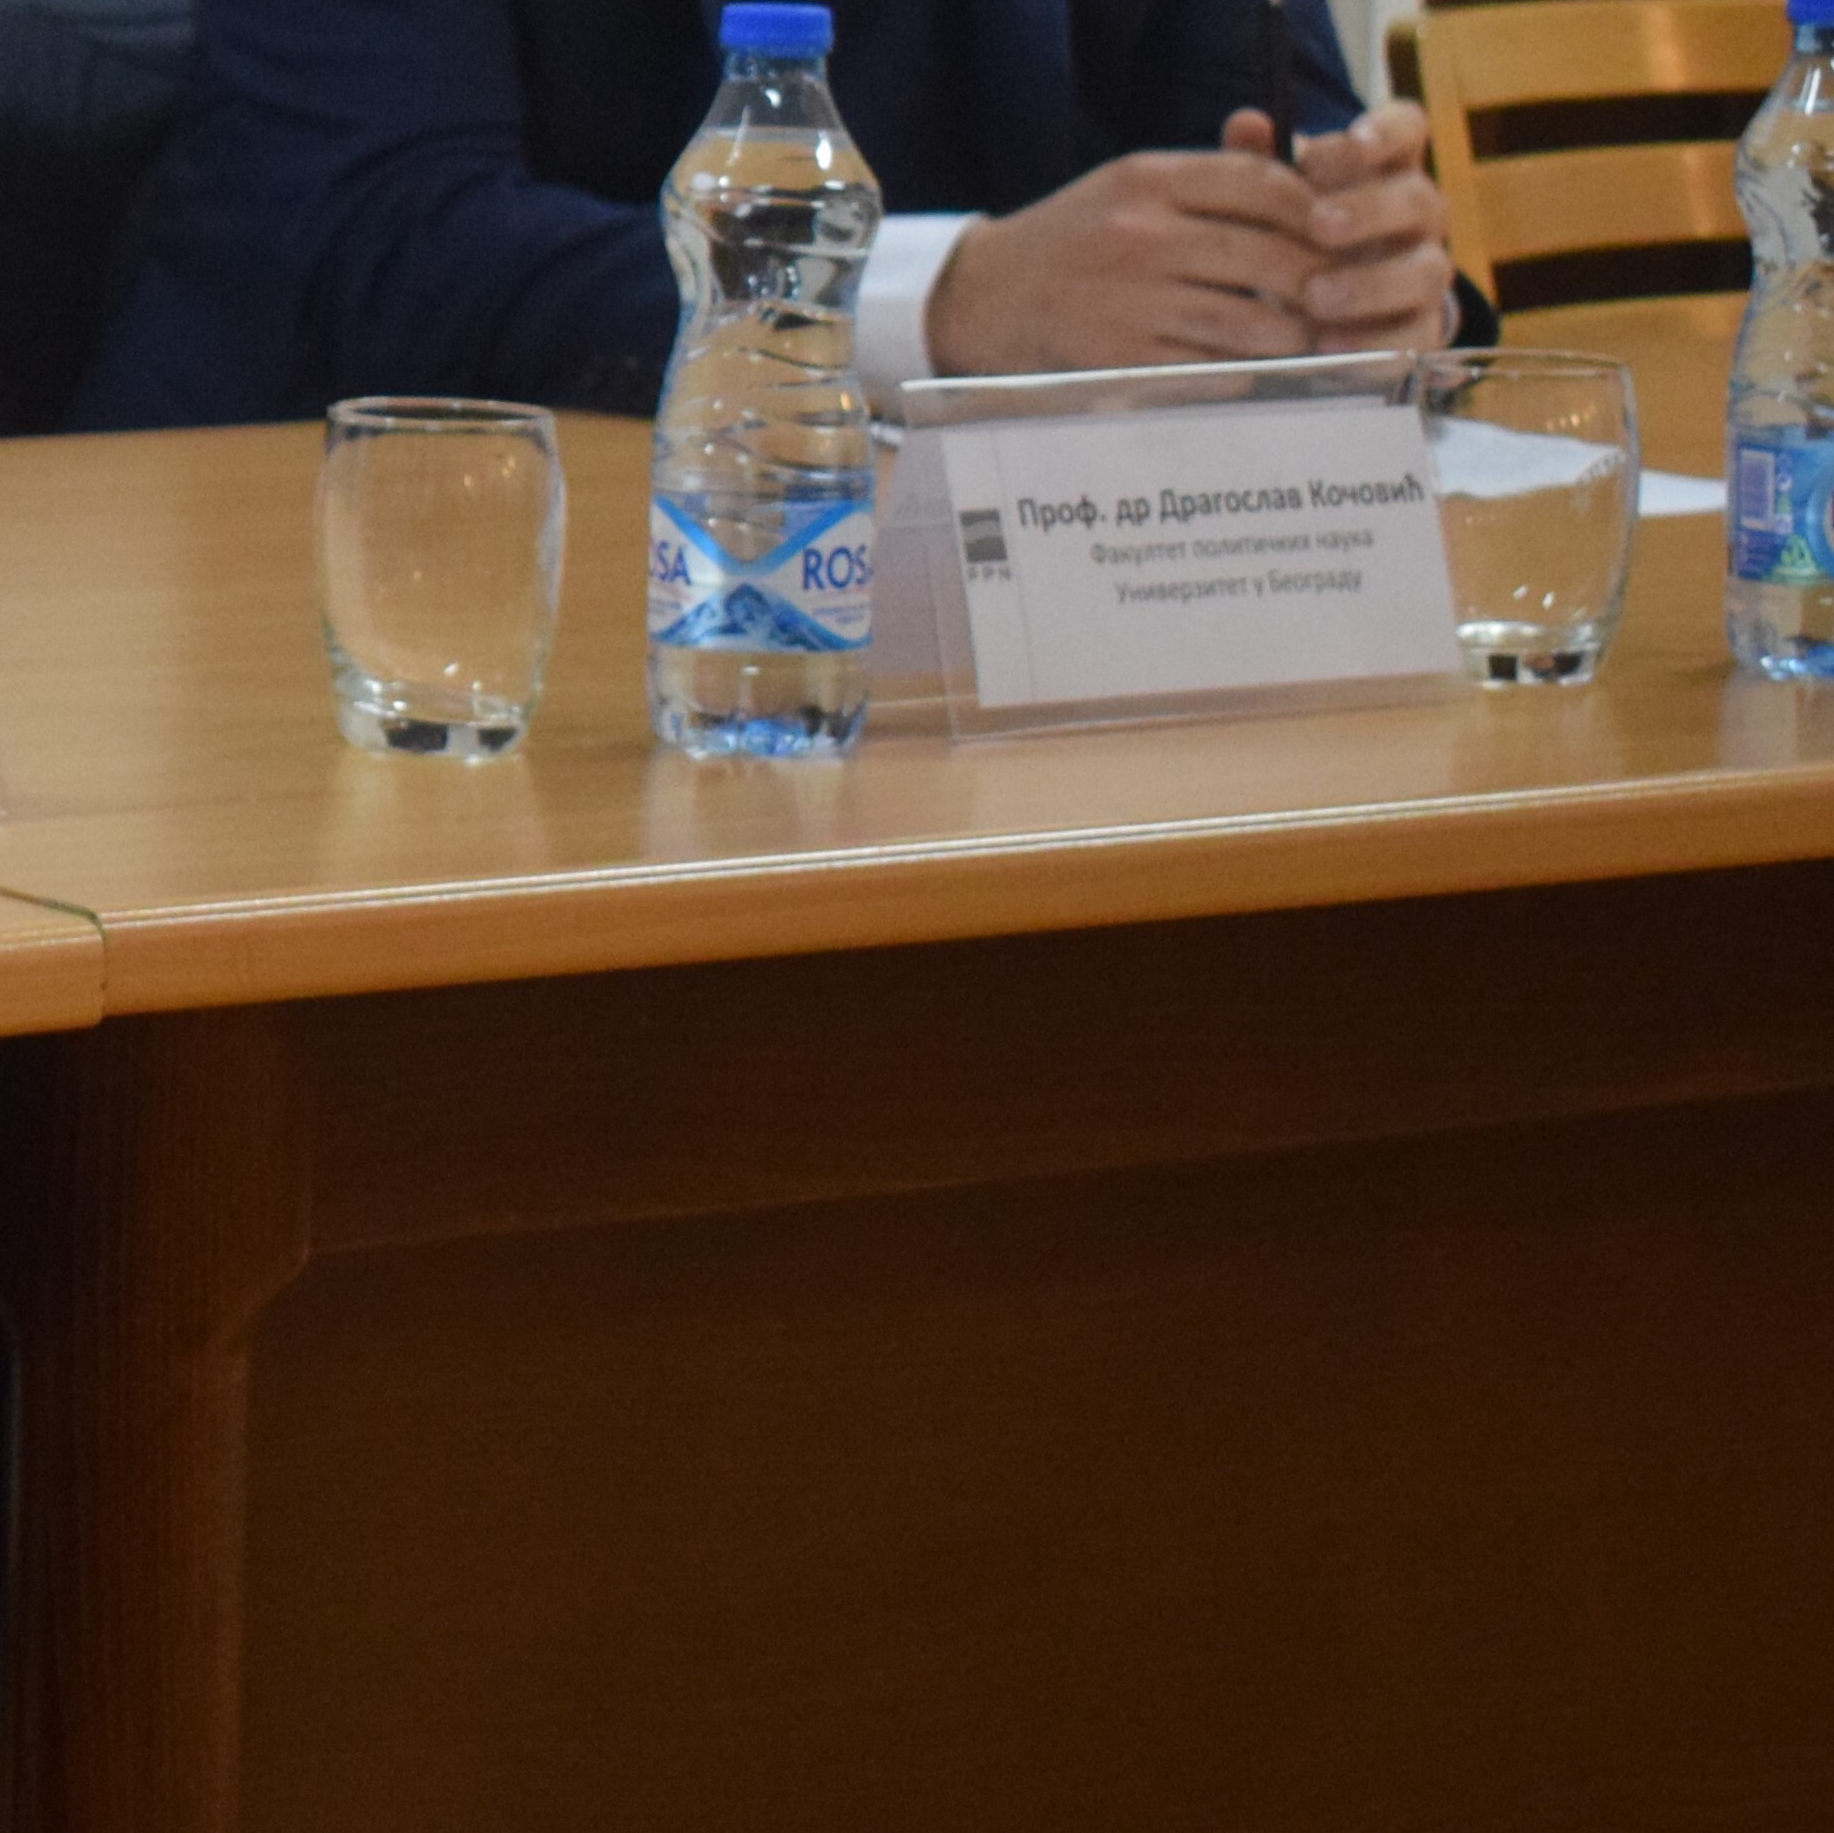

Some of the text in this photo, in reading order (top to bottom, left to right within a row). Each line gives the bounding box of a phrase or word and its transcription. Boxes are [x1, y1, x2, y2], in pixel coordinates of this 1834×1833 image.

[1017, 471, 1425, 533] Проф. др Драгослав Кочовић
[801, 543, 874, 592] ROS
